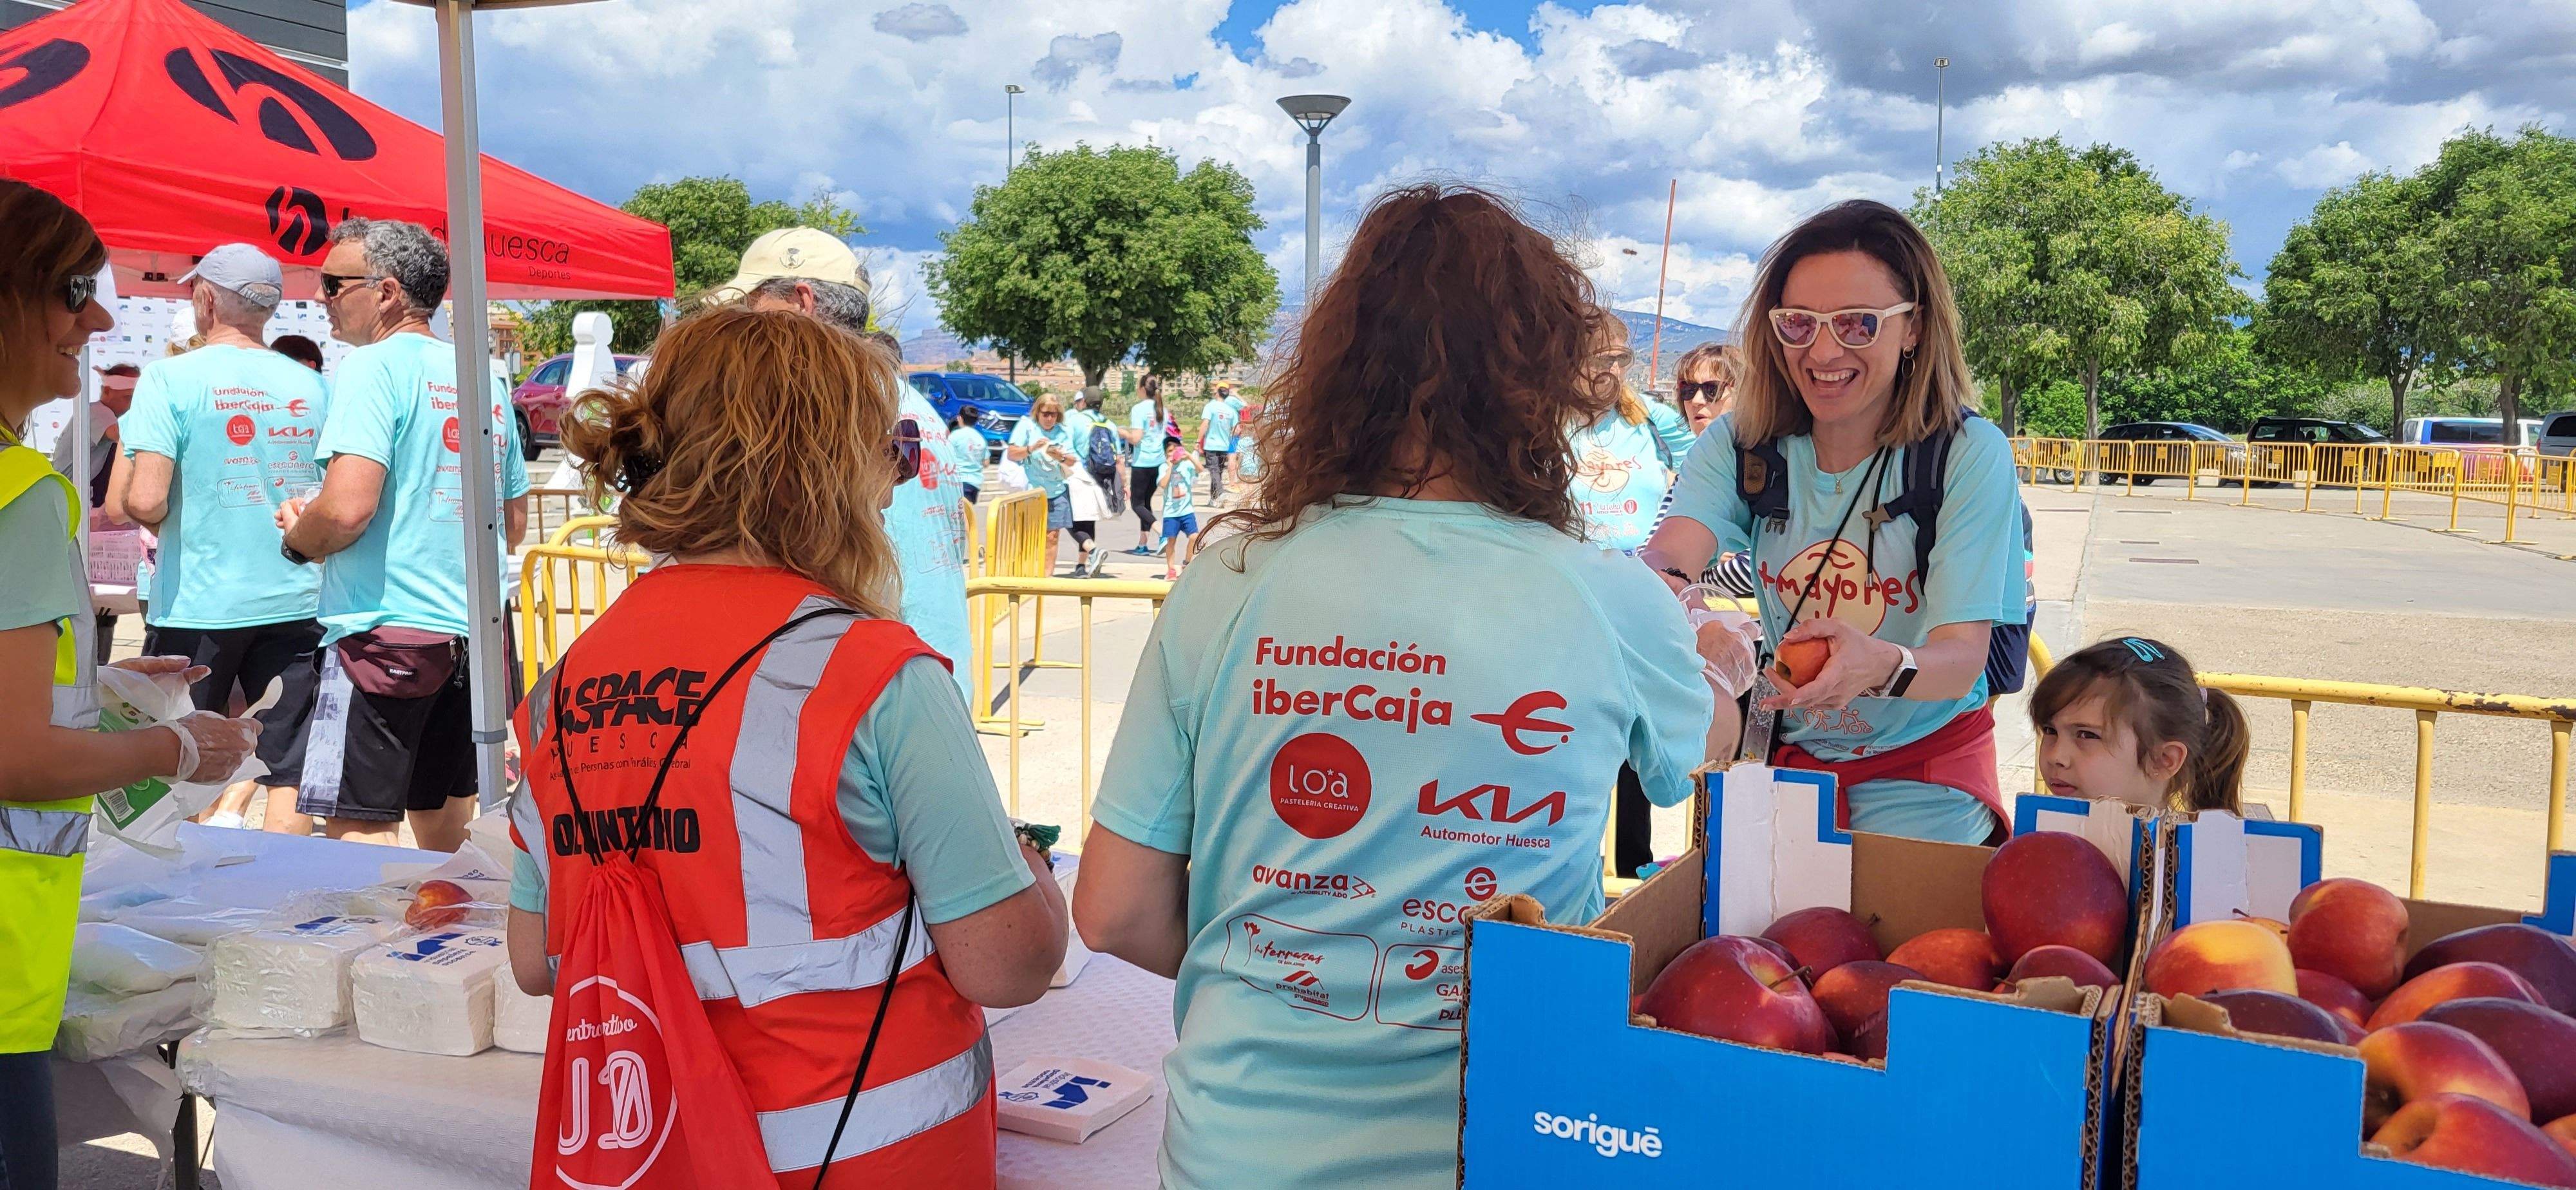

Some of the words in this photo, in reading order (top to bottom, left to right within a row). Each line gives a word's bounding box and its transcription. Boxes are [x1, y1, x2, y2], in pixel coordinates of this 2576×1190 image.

[484, 231, 570, 265] uesca
[528, 265, 571, 281] Deportes
[1255, 635, 1446, 675] Fundación
[1253, 679, 1453, 734] iberCaja
[1323, 802, 1359, 812] CREATIVA
[1417, 779, 1567, 827] KIA
[1420, 825, 1502, 845] Automotor
[1505, 833, 1551, 848] Huesca
[1253, 864, 1349, 891] avanza
